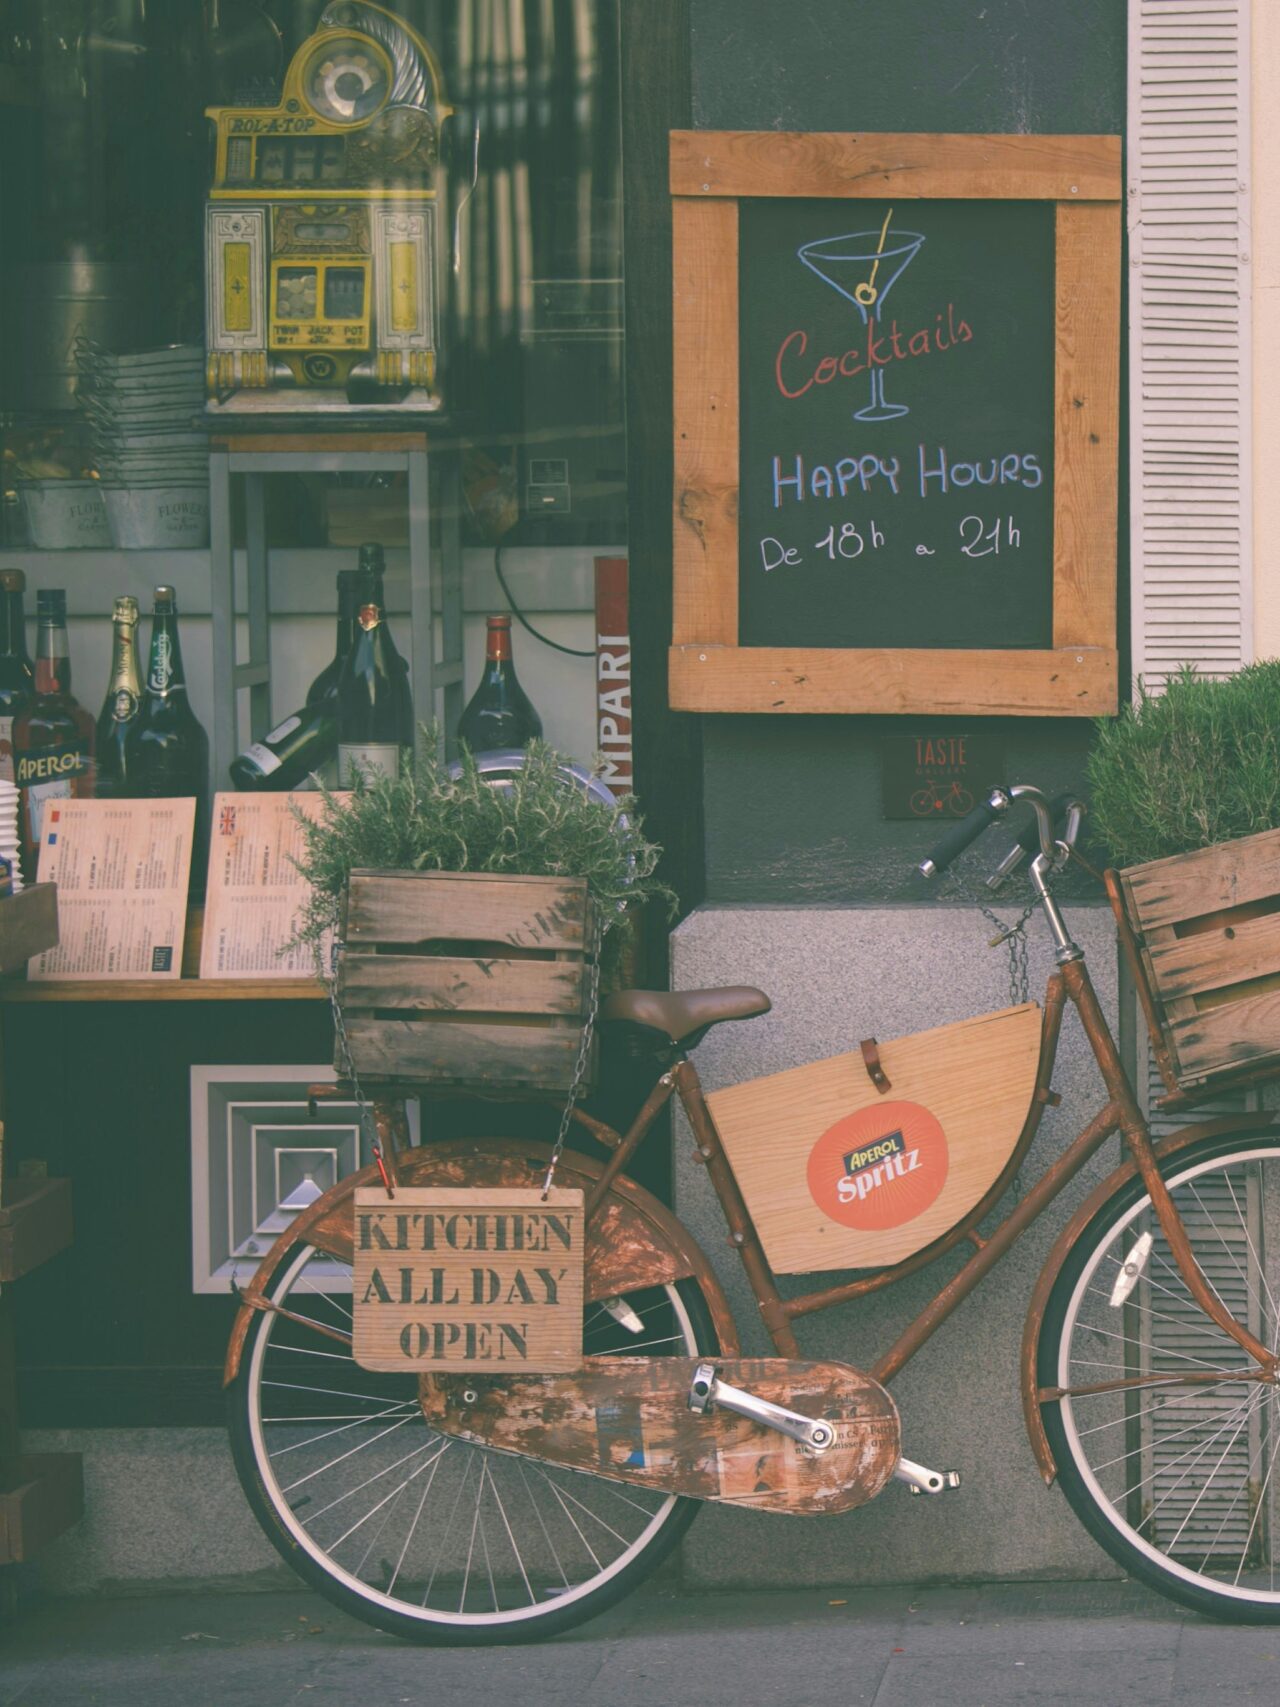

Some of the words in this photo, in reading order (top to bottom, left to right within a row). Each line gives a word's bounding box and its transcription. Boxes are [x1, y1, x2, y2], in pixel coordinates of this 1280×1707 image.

[344, 325, 365, 336] POT
[776, 304, 974, 398] Cocktails
[772, 454, 900, 508] HAPPY
[919, 444, 1043, 498] HOURS
[760, 537, 802, 571] De
[815, 520, 885, 560] 18h
[915, 544, 935, 555] a
[959, 515, 1021, 558] 21h
[17, 751, 83, 782] APEROL
[915, 738, 968, 766] TASTE
[850, 1138, 900, 1171] APEROL
[836, 1148, 923, 1203] Spritz
[357, 1213, 574, 1251] KITCHEN
[361, 1266, 459, 1304] ALL
[470, 1267, 568, 1305] DAY
[399, 1322, 529, 1361] OPEN
